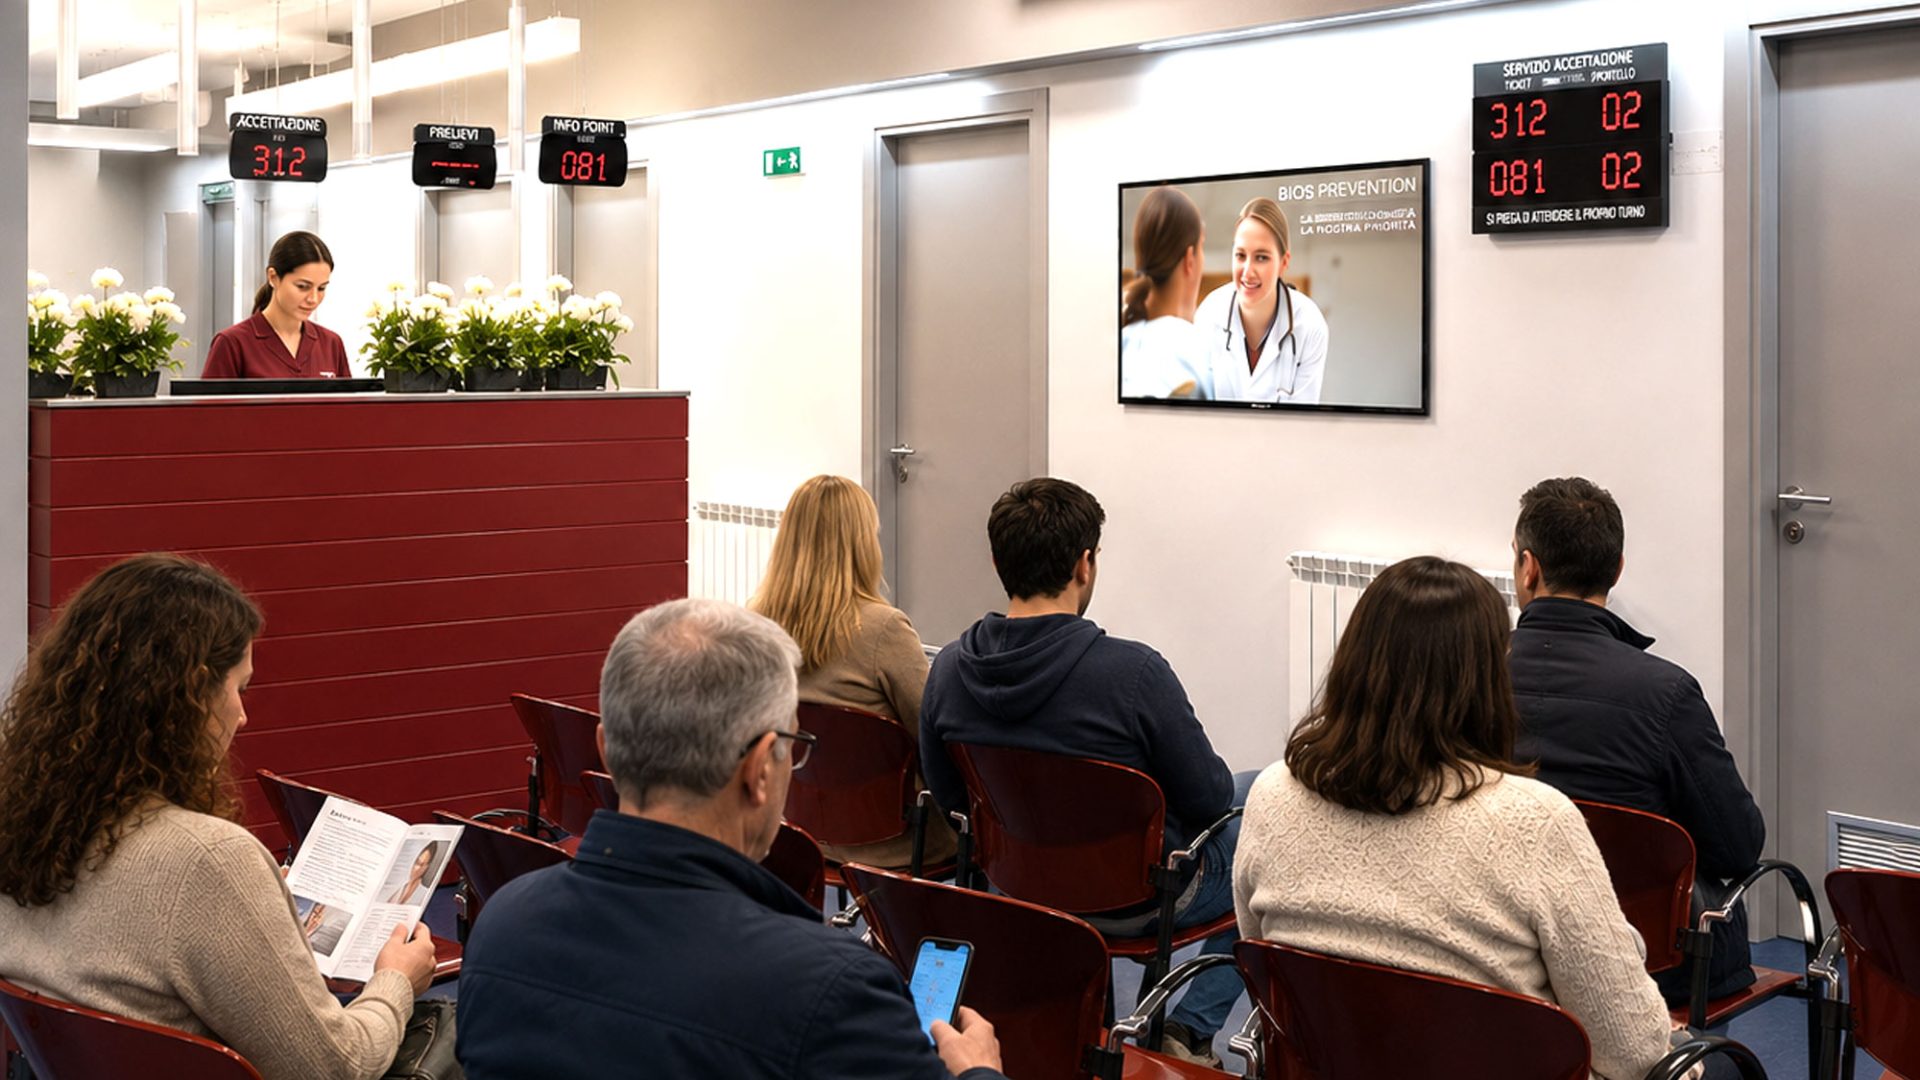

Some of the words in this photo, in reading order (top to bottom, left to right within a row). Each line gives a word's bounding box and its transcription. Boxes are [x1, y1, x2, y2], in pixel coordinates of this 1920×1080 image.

[583, 120, 615, 134] POINT
[1490, 98, 1547, 140] 312
[1602, 90, 1642, 131] 02
[253, 144, 306, 176] 312
[561, 150, 607, 181] 081
[1490, 158, 1546, 197] 081
[1601, 151, 1642, 191] 02
[1278, 184, 1315, 201] BIOS
[1318, 176, 1416, 198] PREVENTION
